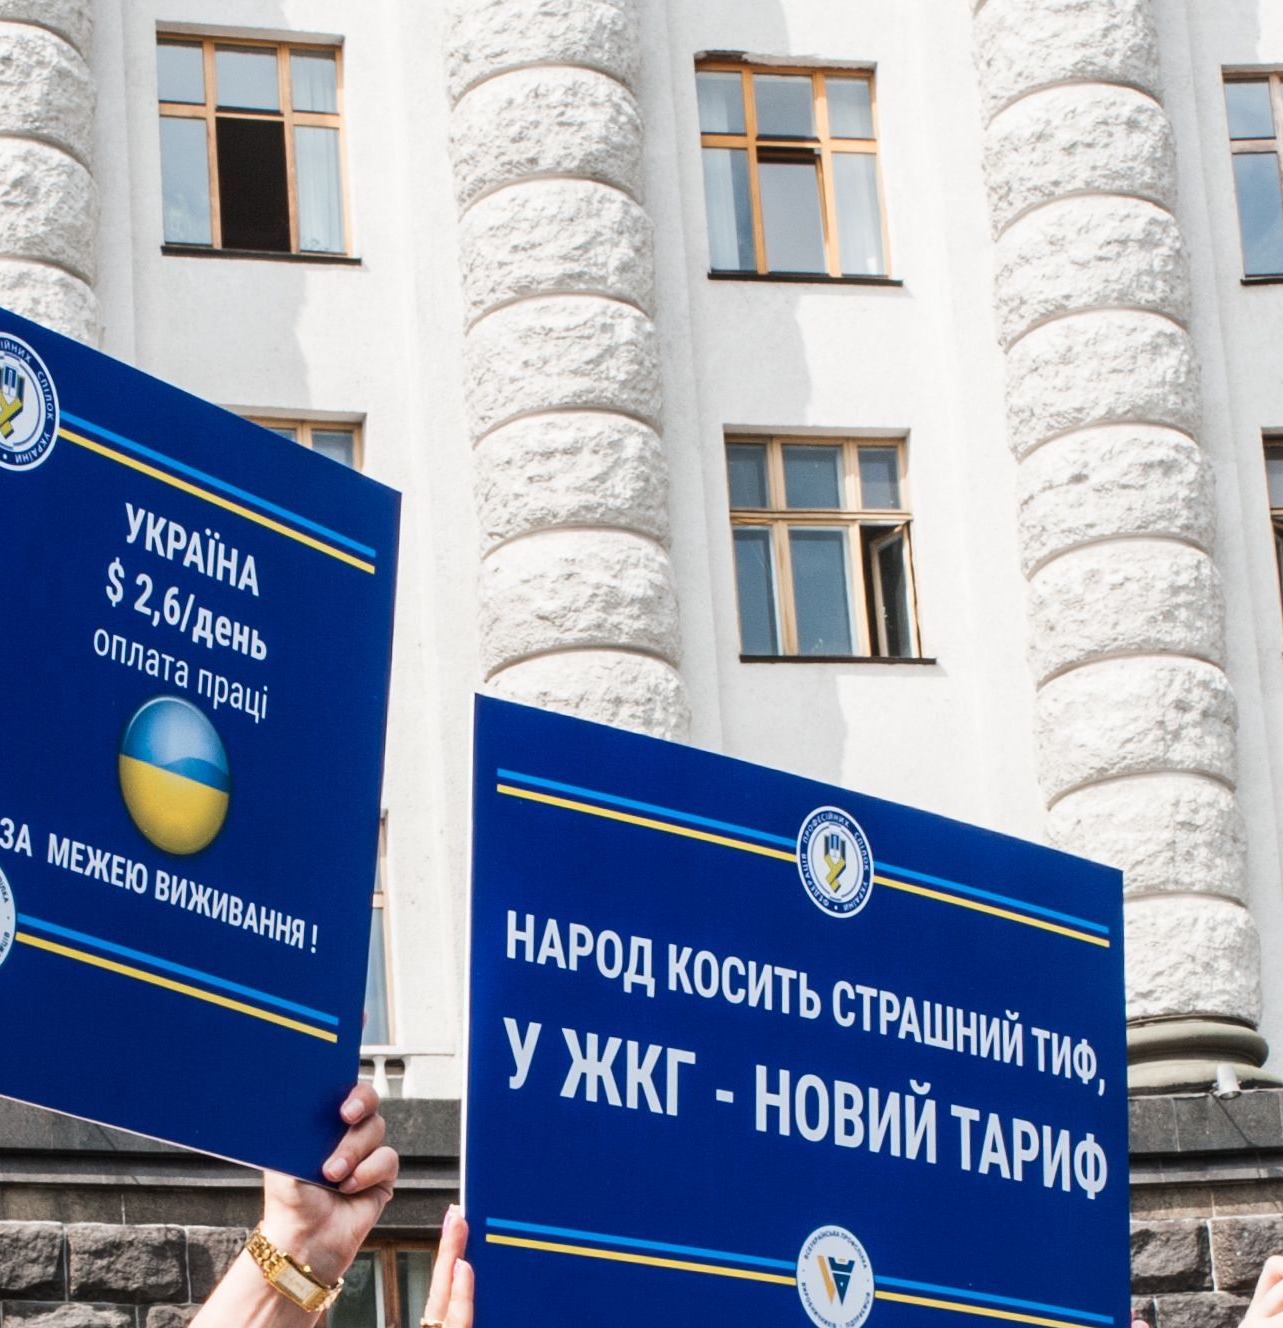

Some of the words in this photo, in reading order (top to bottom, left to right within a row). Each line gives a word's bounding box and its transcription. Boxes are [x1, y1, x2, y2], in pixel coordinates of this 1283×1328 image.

[37, 370, 54, 421] СПІЛОК
[14, 431, 51, 464] УКРАЇНИ
[125, 502, 259, 597] УКРАЇНА
[106, 557, 125, 607] $
[134, 573, 267, 662] 2,6/день
[93, 628, 189, 688] оплата
[198, 668, 267, 724] праці
[47, 832, 148, 894] МЕЖЕЮ
[154, 869, 305, 949] ВИЖИВАННЯ
[506, 910, 656, 998] НАРОД
[668, 943, 822, 1019] КОСИТЬ
[832, 980, 1023, 1067] СТРАШНИЙ
[1031, 1027, 1106, 1096] ТИФ,
[503, 1017, 542, 1090] У
[560, 1027, 696, 1116] ЖКГ
[755, 1064, 937, 1164] НОВИЙ
[950, 1104, 1108, 1200] ТАРИФ
